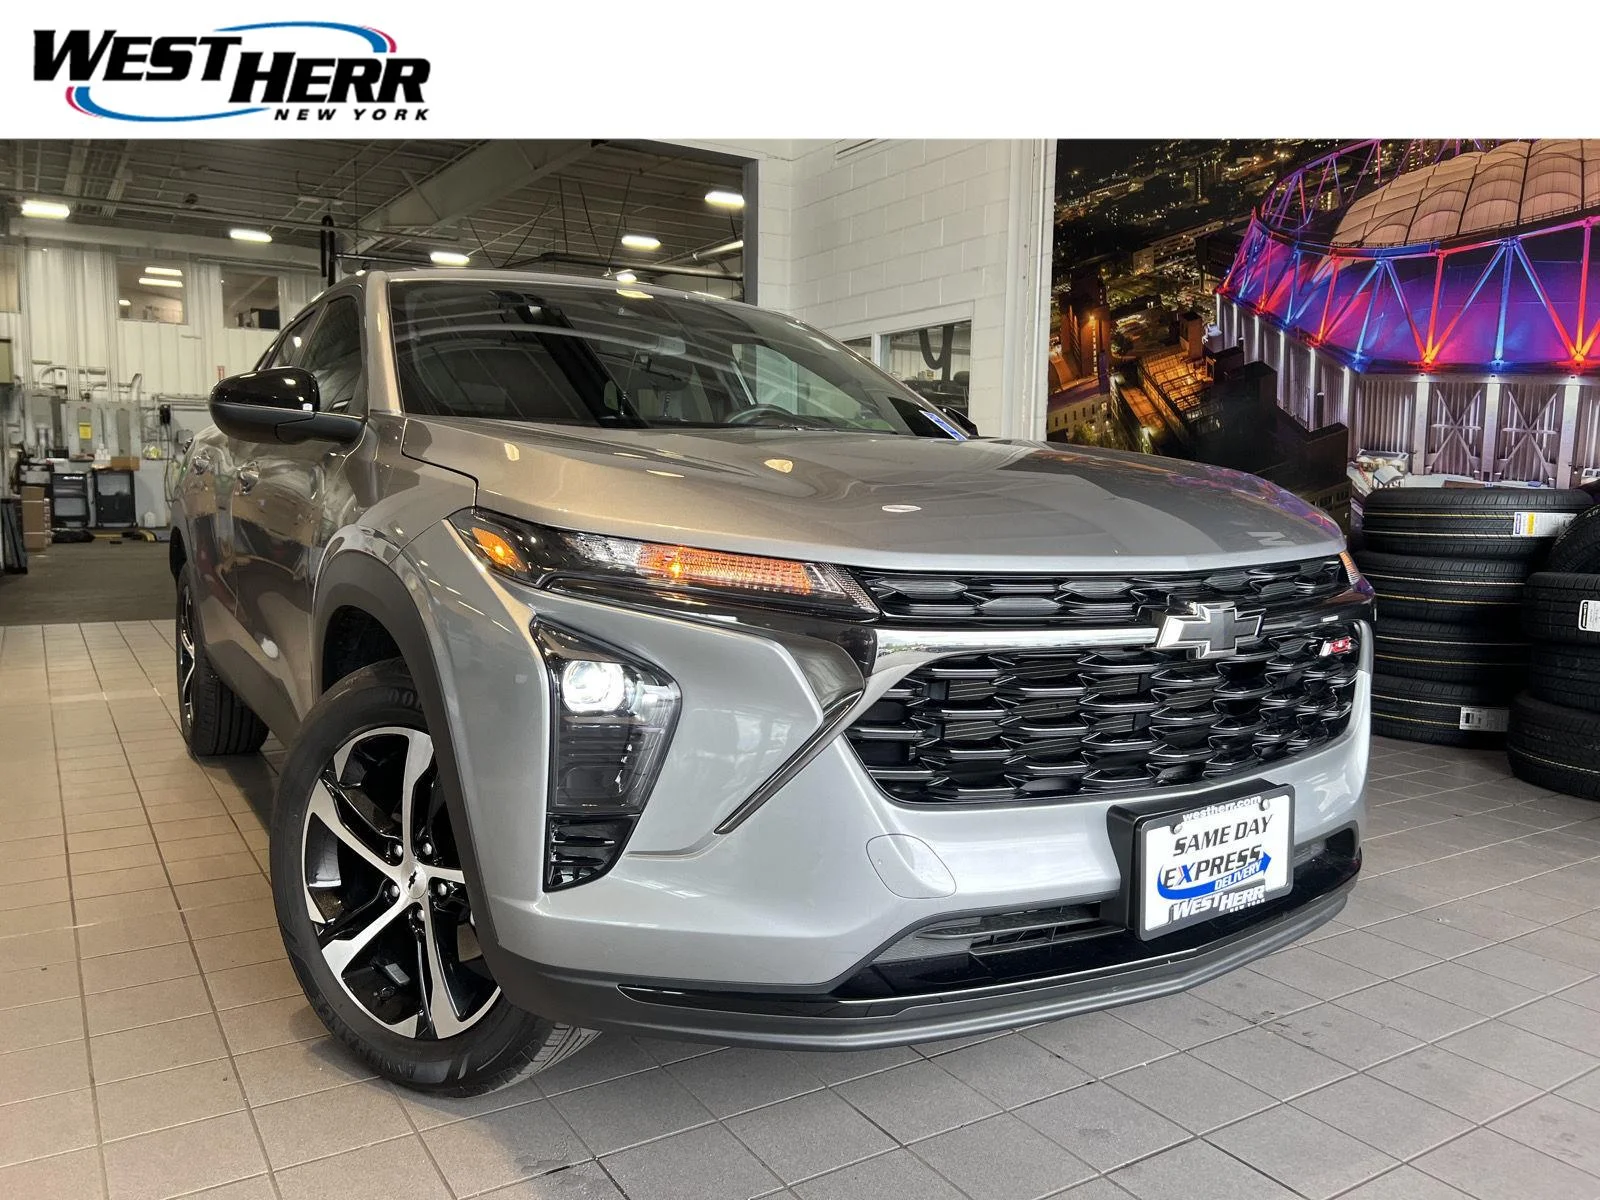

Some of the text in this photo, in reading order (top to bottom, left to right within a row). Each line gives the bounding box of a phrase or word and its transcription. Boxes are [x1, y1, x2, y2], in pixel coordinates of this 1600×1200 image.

[1182, 795, 1262, 822] westherr.com
[1173, 814, 1274, 857] SAME DAY
[1163, 844, 1262, 889] EXPRESS
[1214, 860, 1263, 891] DELIVERY
[1173, 892, 1225, 921] WEST
[1219, 884, 1266, 912] HERR
